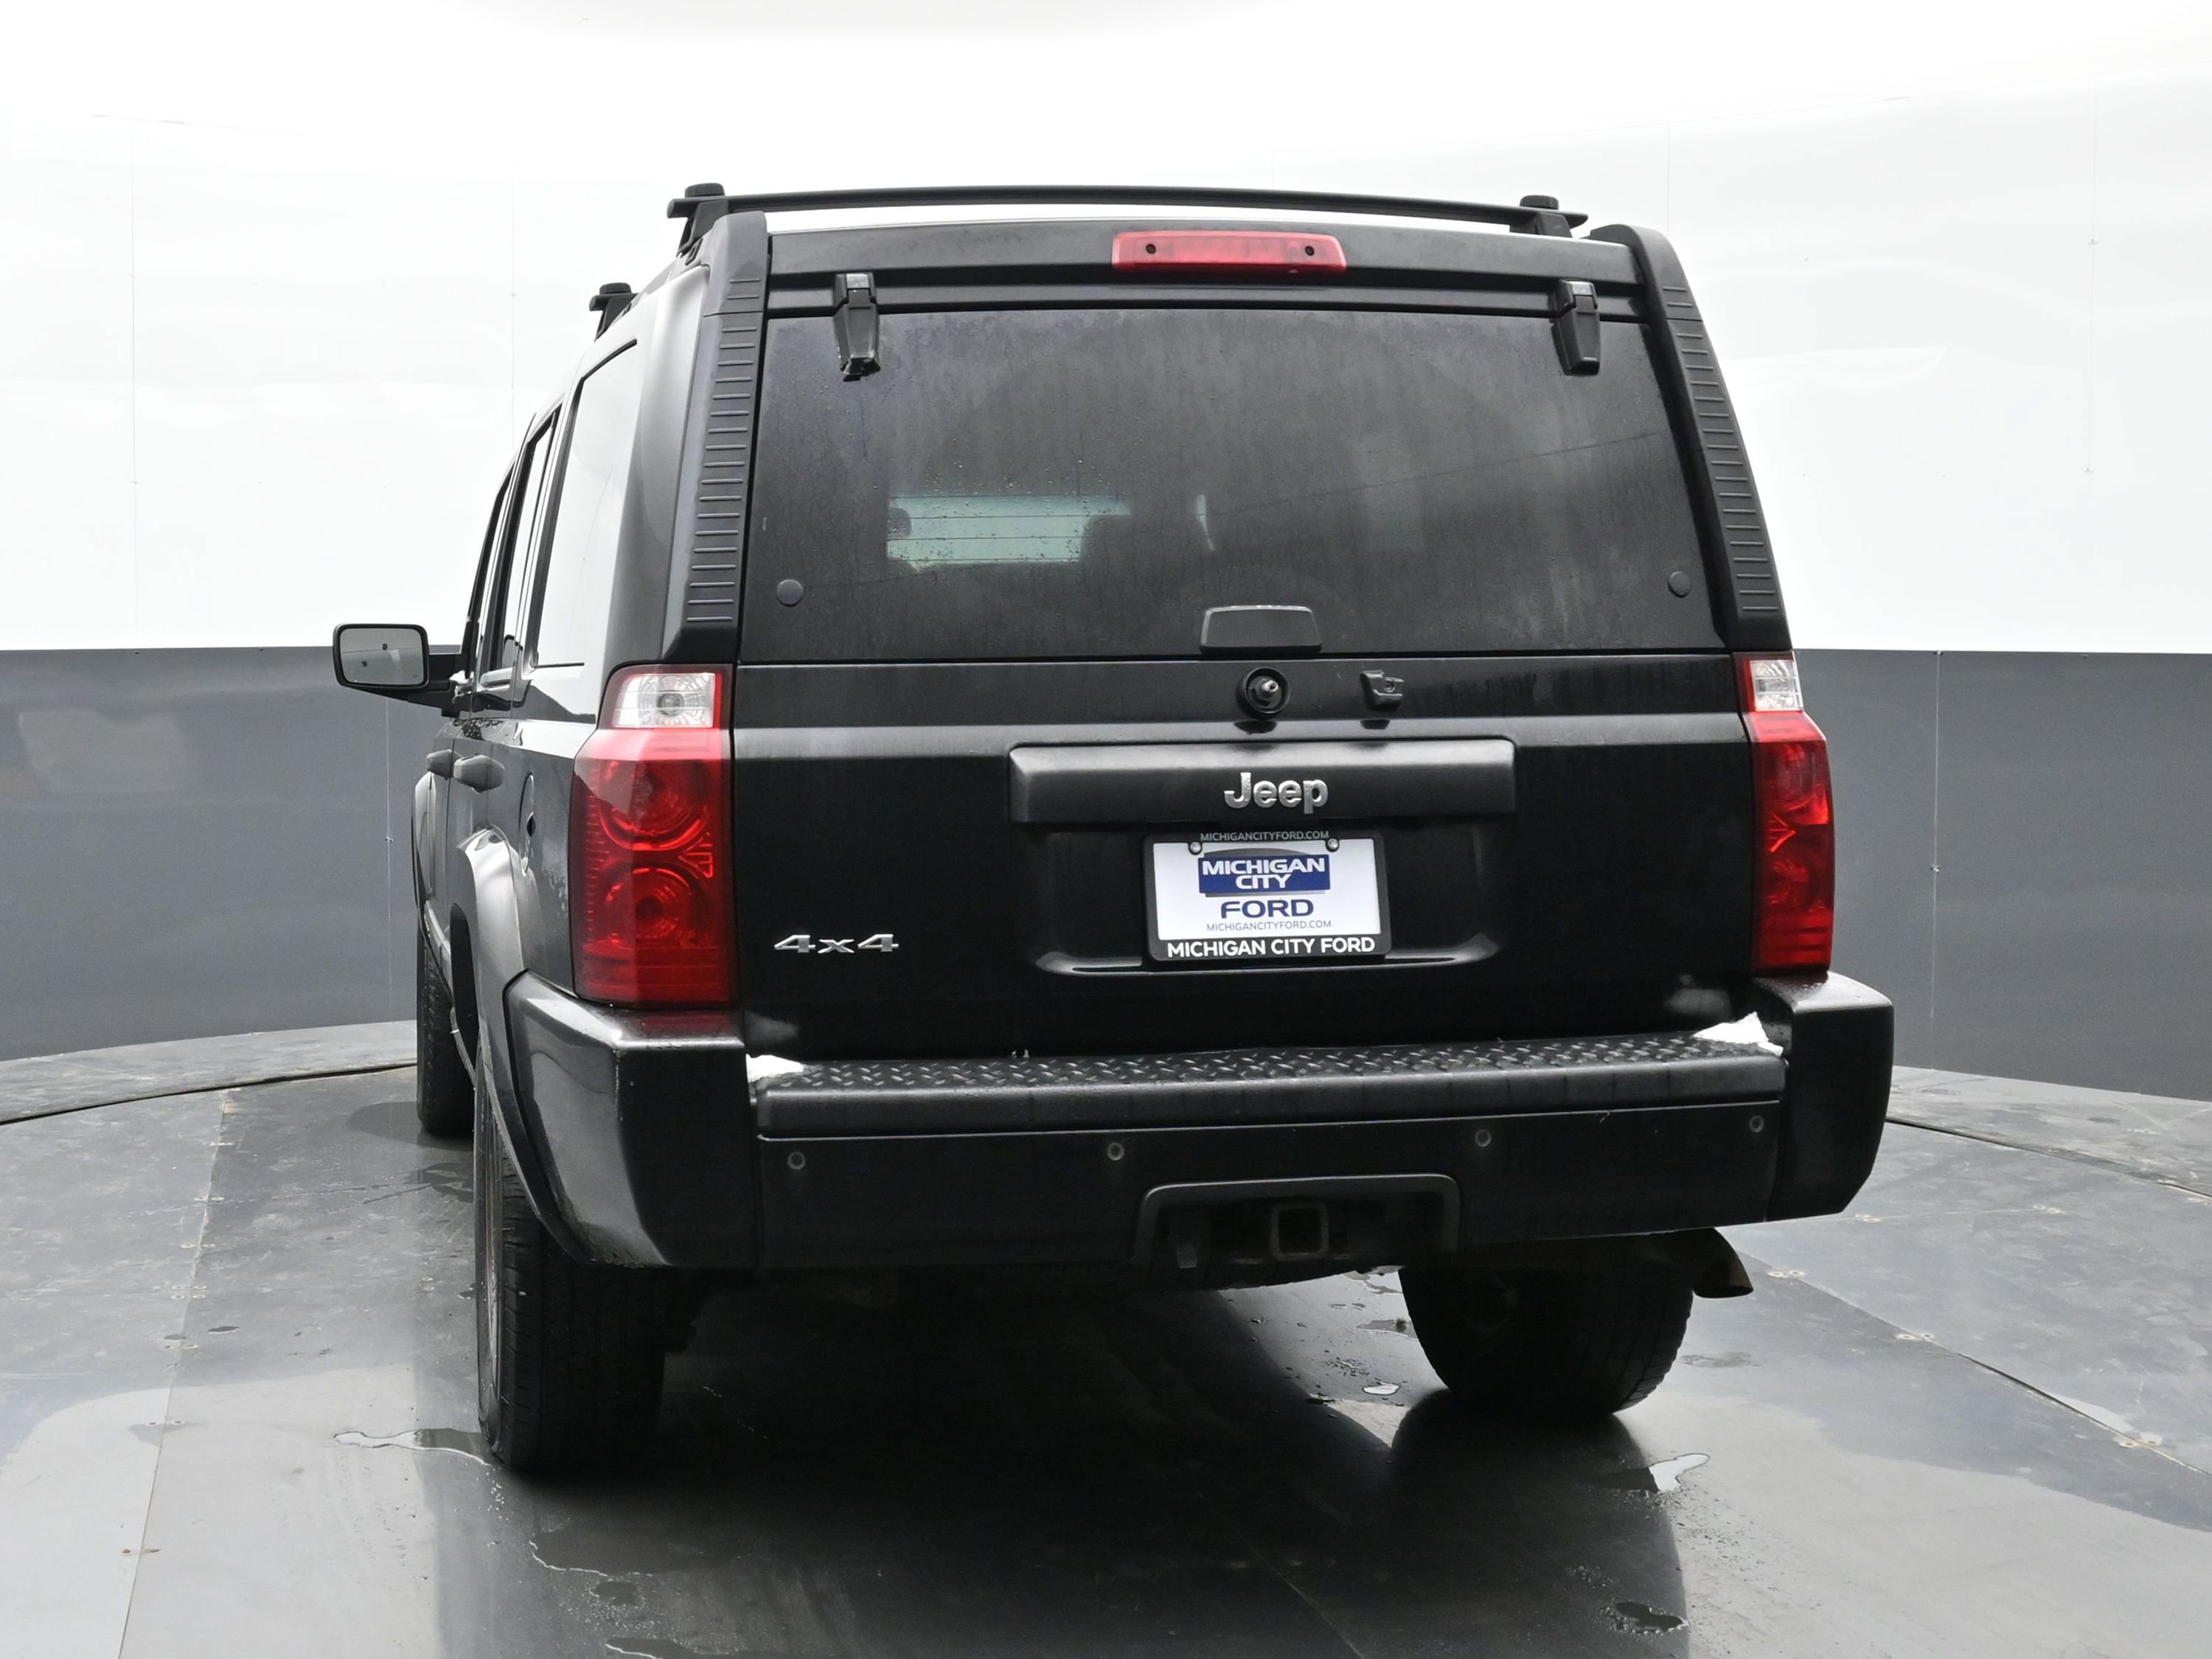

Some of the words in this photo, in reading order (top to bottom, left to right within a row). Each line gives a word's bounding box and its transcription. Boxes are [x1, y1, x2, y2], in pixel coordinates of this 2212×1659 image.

[1224, 772, 1328, 814] Jeep
[1200, 830, 1330, 841] MICHIGANCITYFORD.COM
[1202, 858, 1326, 875] MICHIGAN
[1235, 874, 1291, 890] CITY
[1220, 899, 1314, 919] FORD
[1206, 920, 1332, 932] MICHIGANCITYFORD.COM
[774, 933, 900, 953] 4x4
[1167, 939, 1266, 958] MICHIGAN
[1270, 938, 1315, 955] CITY
[1321, 936, 1376, 953] FORD
